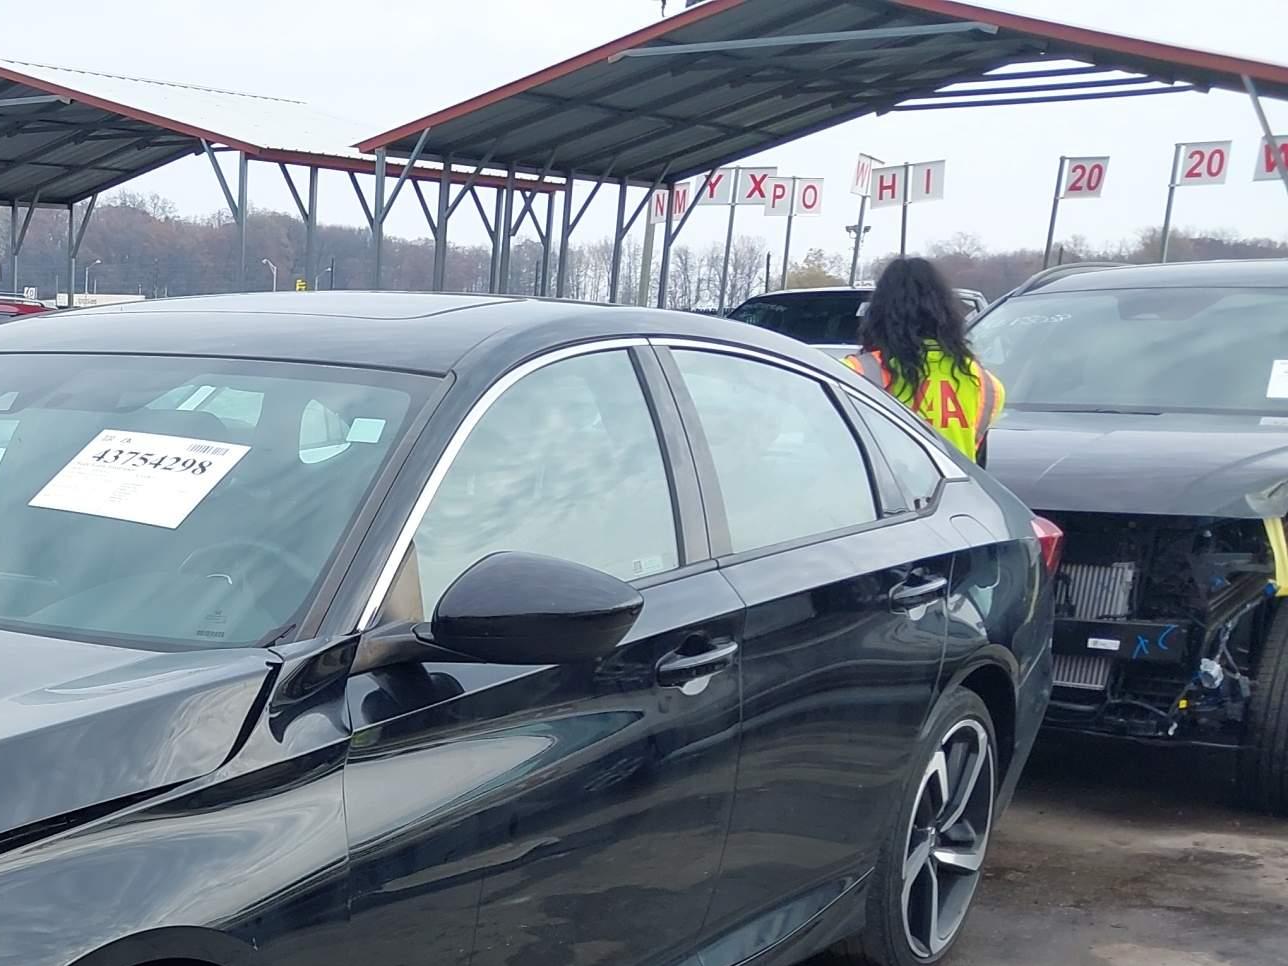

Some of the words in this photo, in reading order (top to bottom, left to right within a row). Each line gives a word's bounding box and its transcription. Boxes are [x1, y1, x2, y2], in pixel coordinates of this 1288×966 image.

[1184, 149, 1225, 178] 20
[704, 174, 723, 198] Y
[746, 174, 768, 198] X
[878, 173, 896, 200] H
[925, 168, 931, 194] I
[1068, 164, 1103, 191] 20
[655, 192, 665, 216] N
[674, 190, 686, 214] M
[771, 184, 785, 208] P
[802, 184, 817, 209] O
[92, 449, 212, 475] 43754298
